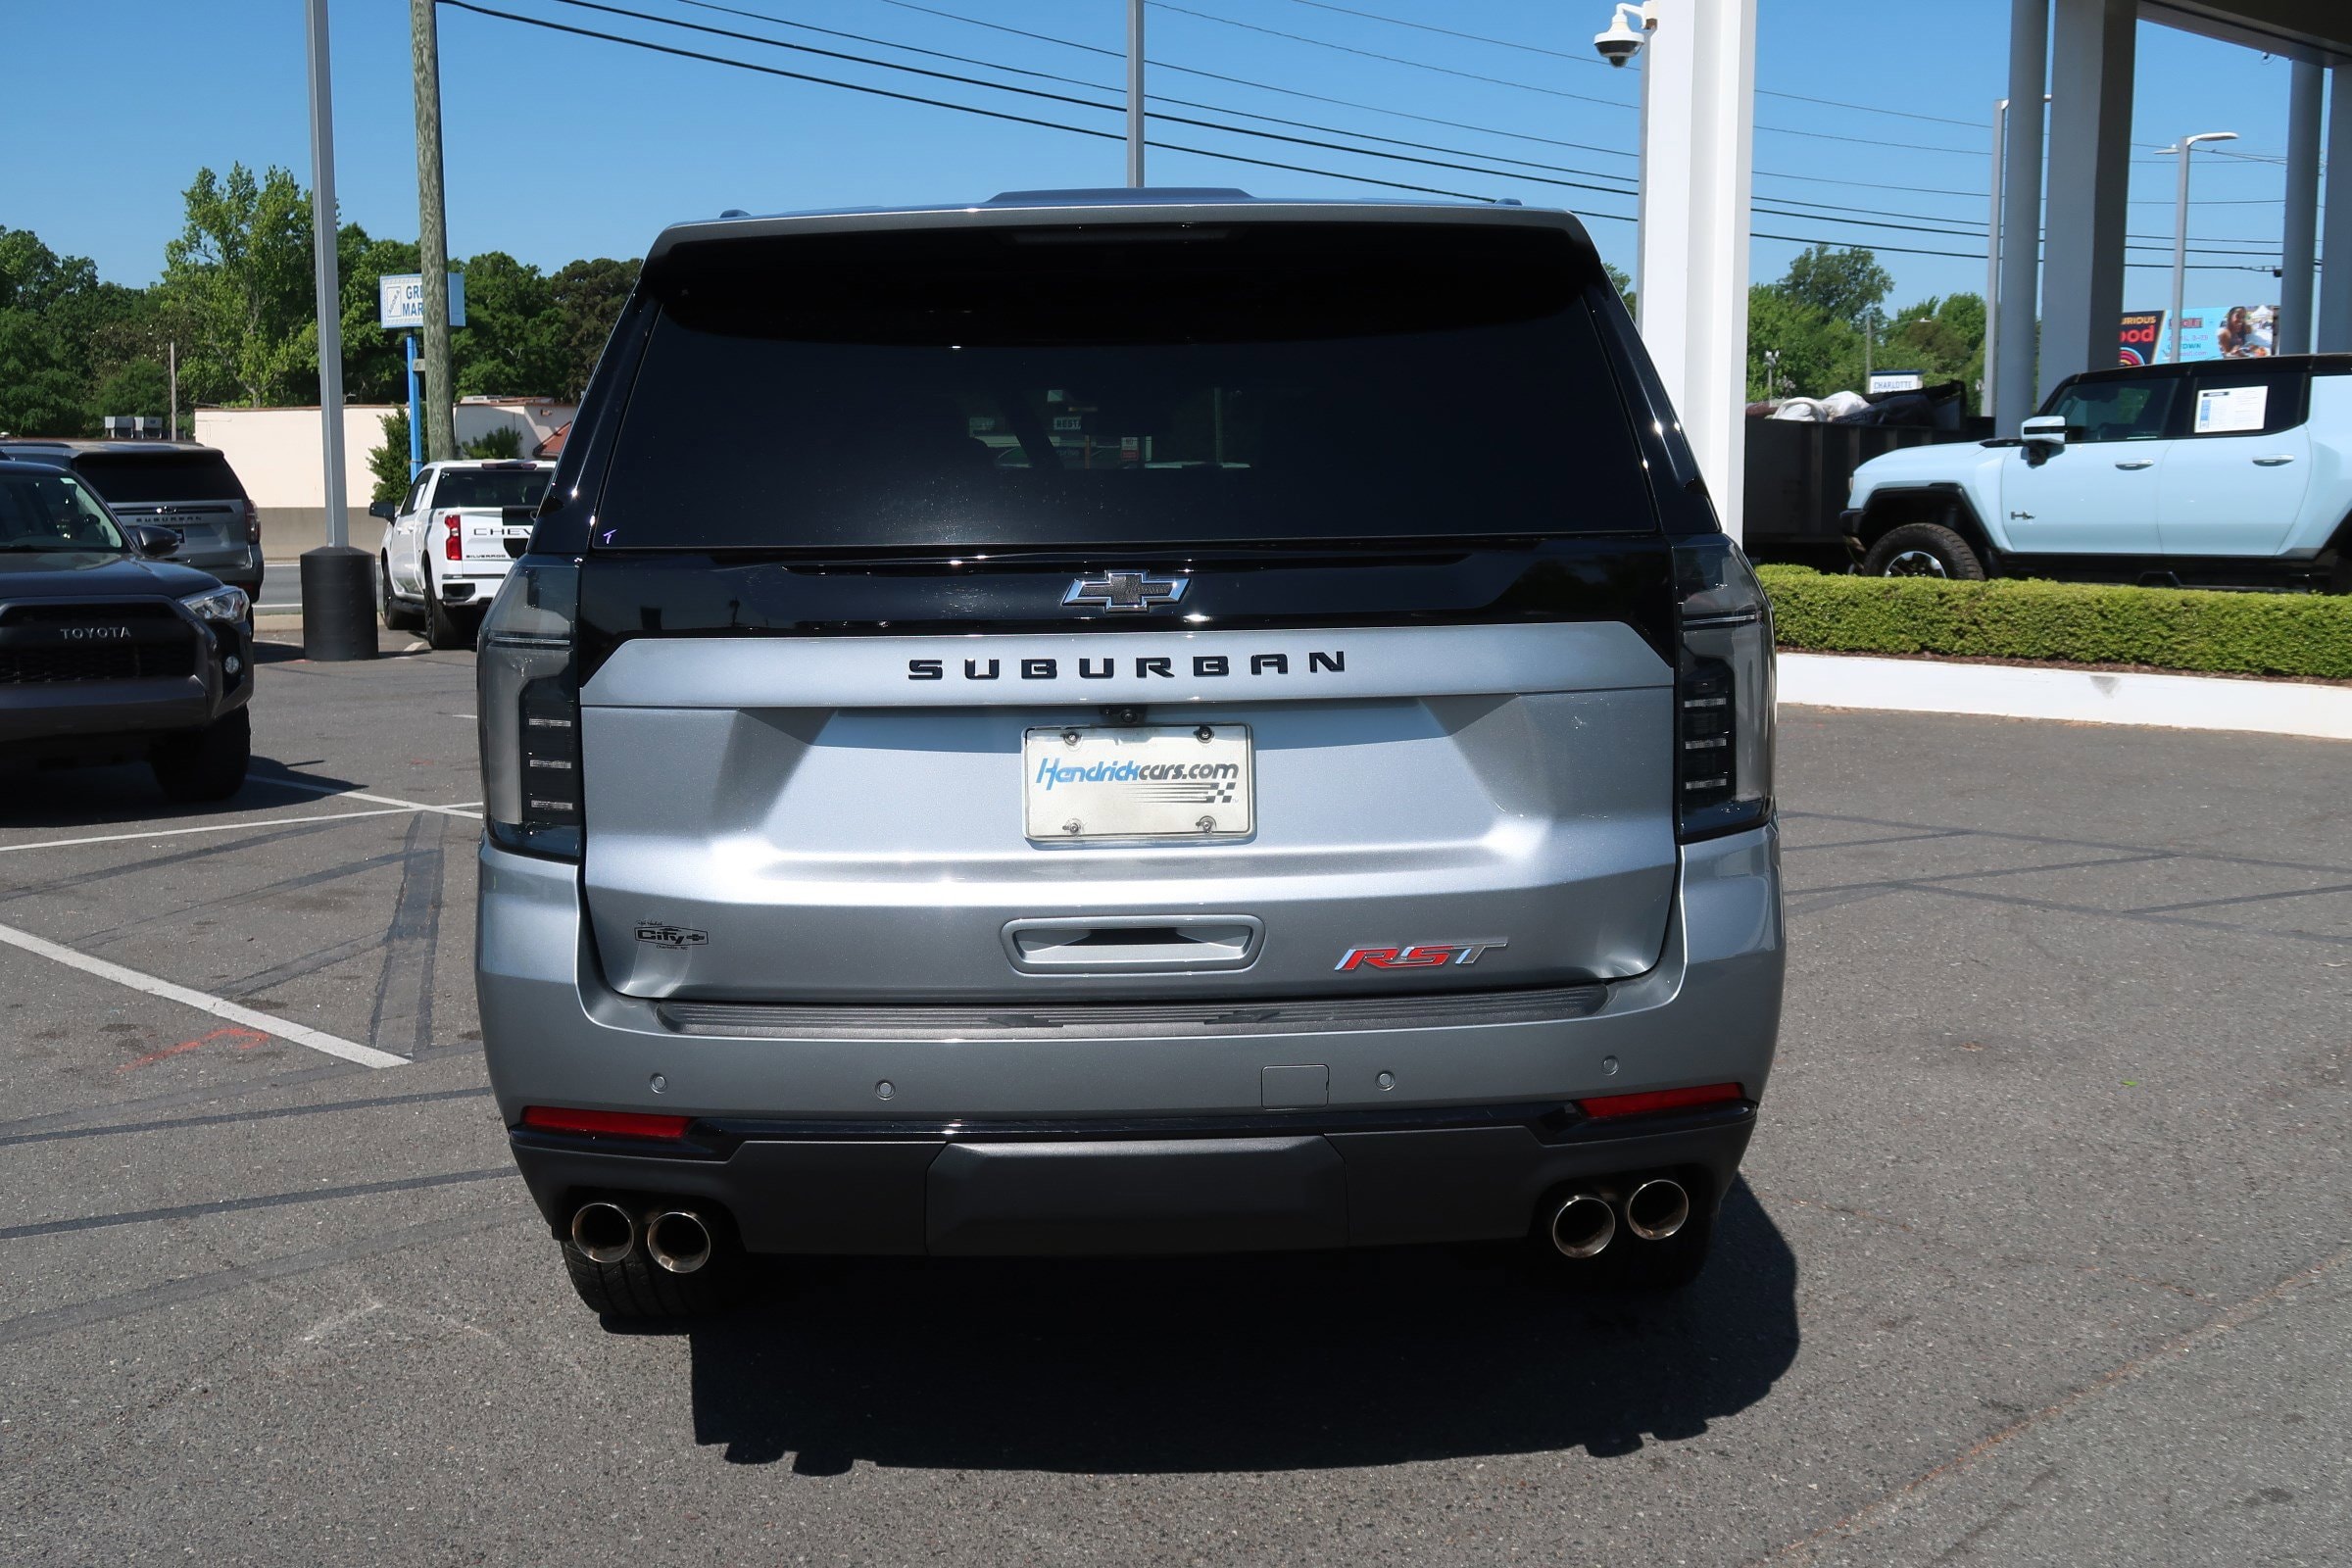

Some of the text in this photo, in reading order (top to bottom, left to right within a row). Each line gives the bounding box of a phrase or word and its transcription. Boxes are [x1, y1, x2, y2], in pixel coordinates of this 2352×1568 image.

[1873, 380, 1913, 389] CHARLOTTE
[60, 626, 131, 640] TOYOTA
[907, 651, 1346, 680] SUBURBAN
[1035, 758, 1240, 791] Hendrickcars.com
[637, 929, 685, 945] City
[1334, 941, 1508, 971] RST
